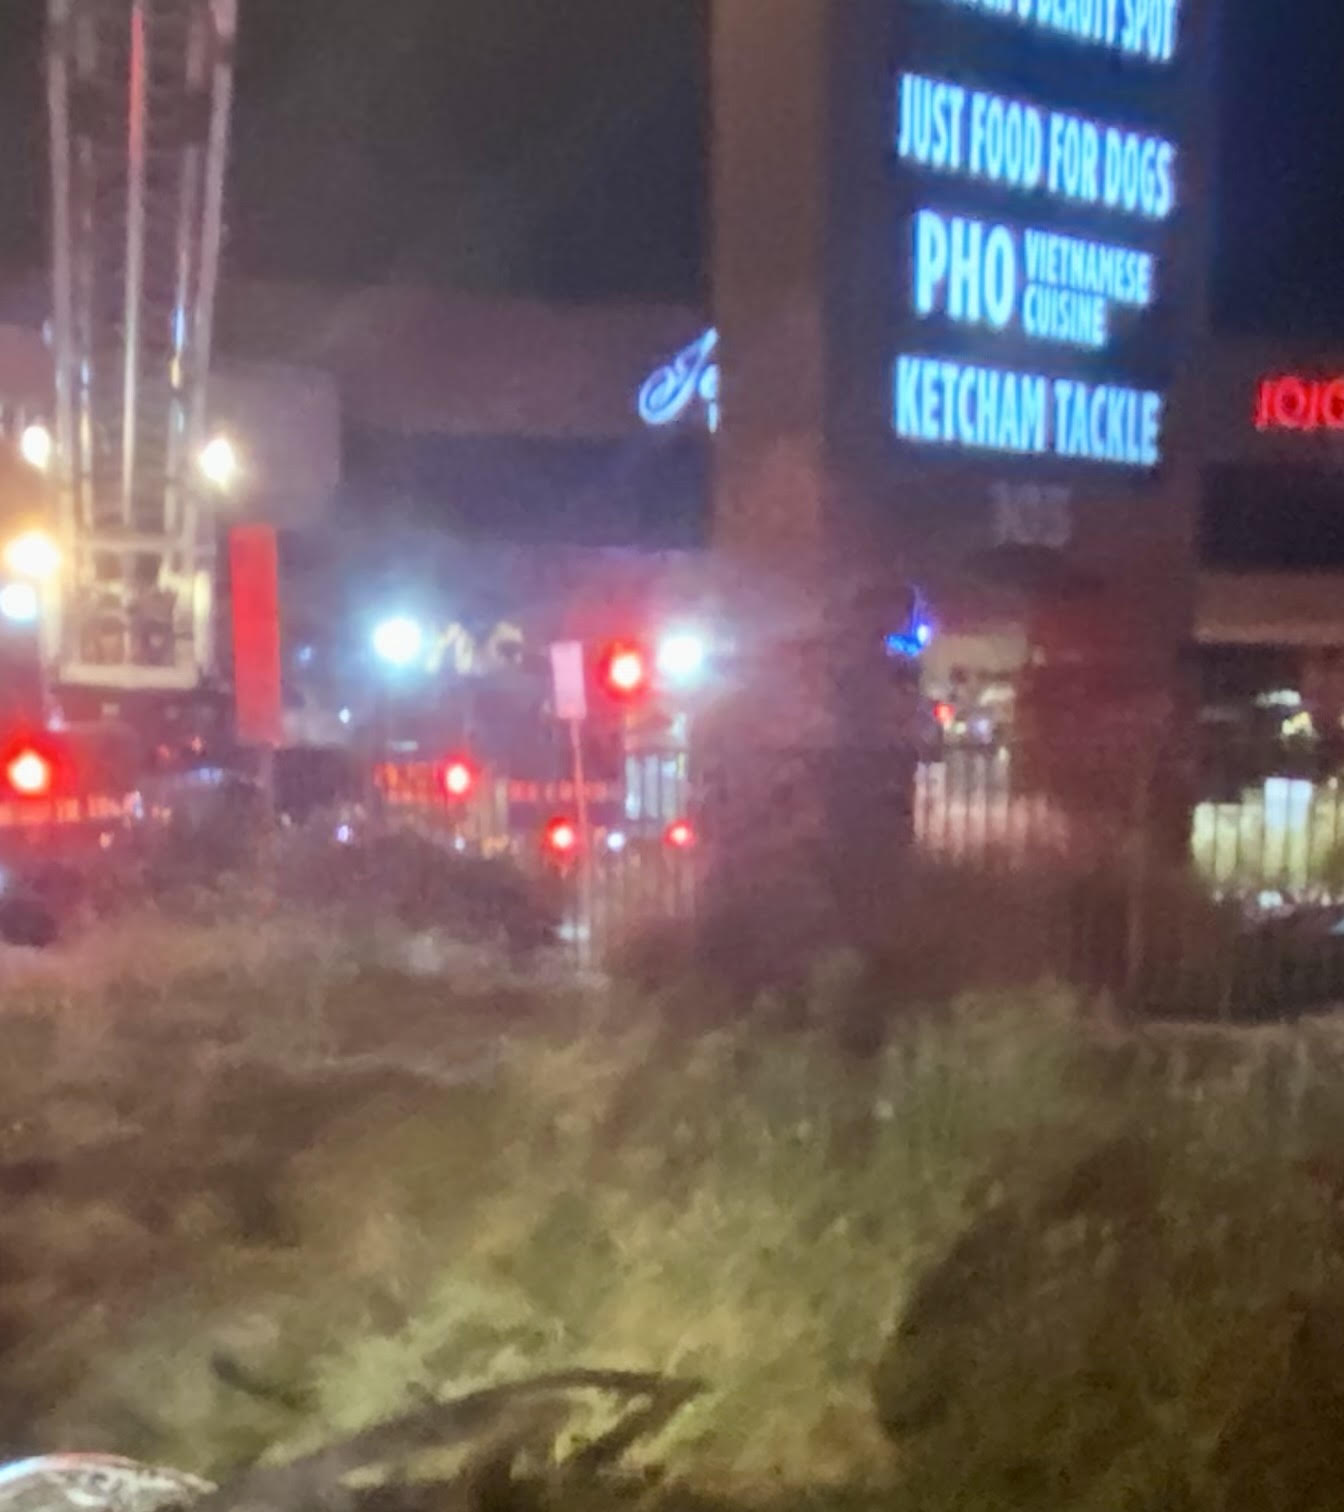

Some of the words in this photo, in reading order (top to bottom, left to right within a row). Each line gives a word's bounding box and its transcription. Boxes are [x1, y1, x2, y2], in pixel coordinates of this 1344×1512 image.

[1121, 0, 1175, 61] SPOT
[898, 72, 964, 170] JUST
[969, 91, 1043, 188] FOOD
[1047, 111, 1099, 200] FOR
[1106, 127, 1176, 219] DOGS
[915, 208, 1016, 327] PHO
[1025, 227, 1154, 306] VIETNAMESE
[1023, 283, 1105, 348] CUISINE
[894, 355, 1047, 452] KETCHAM
[1053, 378, 1164, 467] TACKLE
